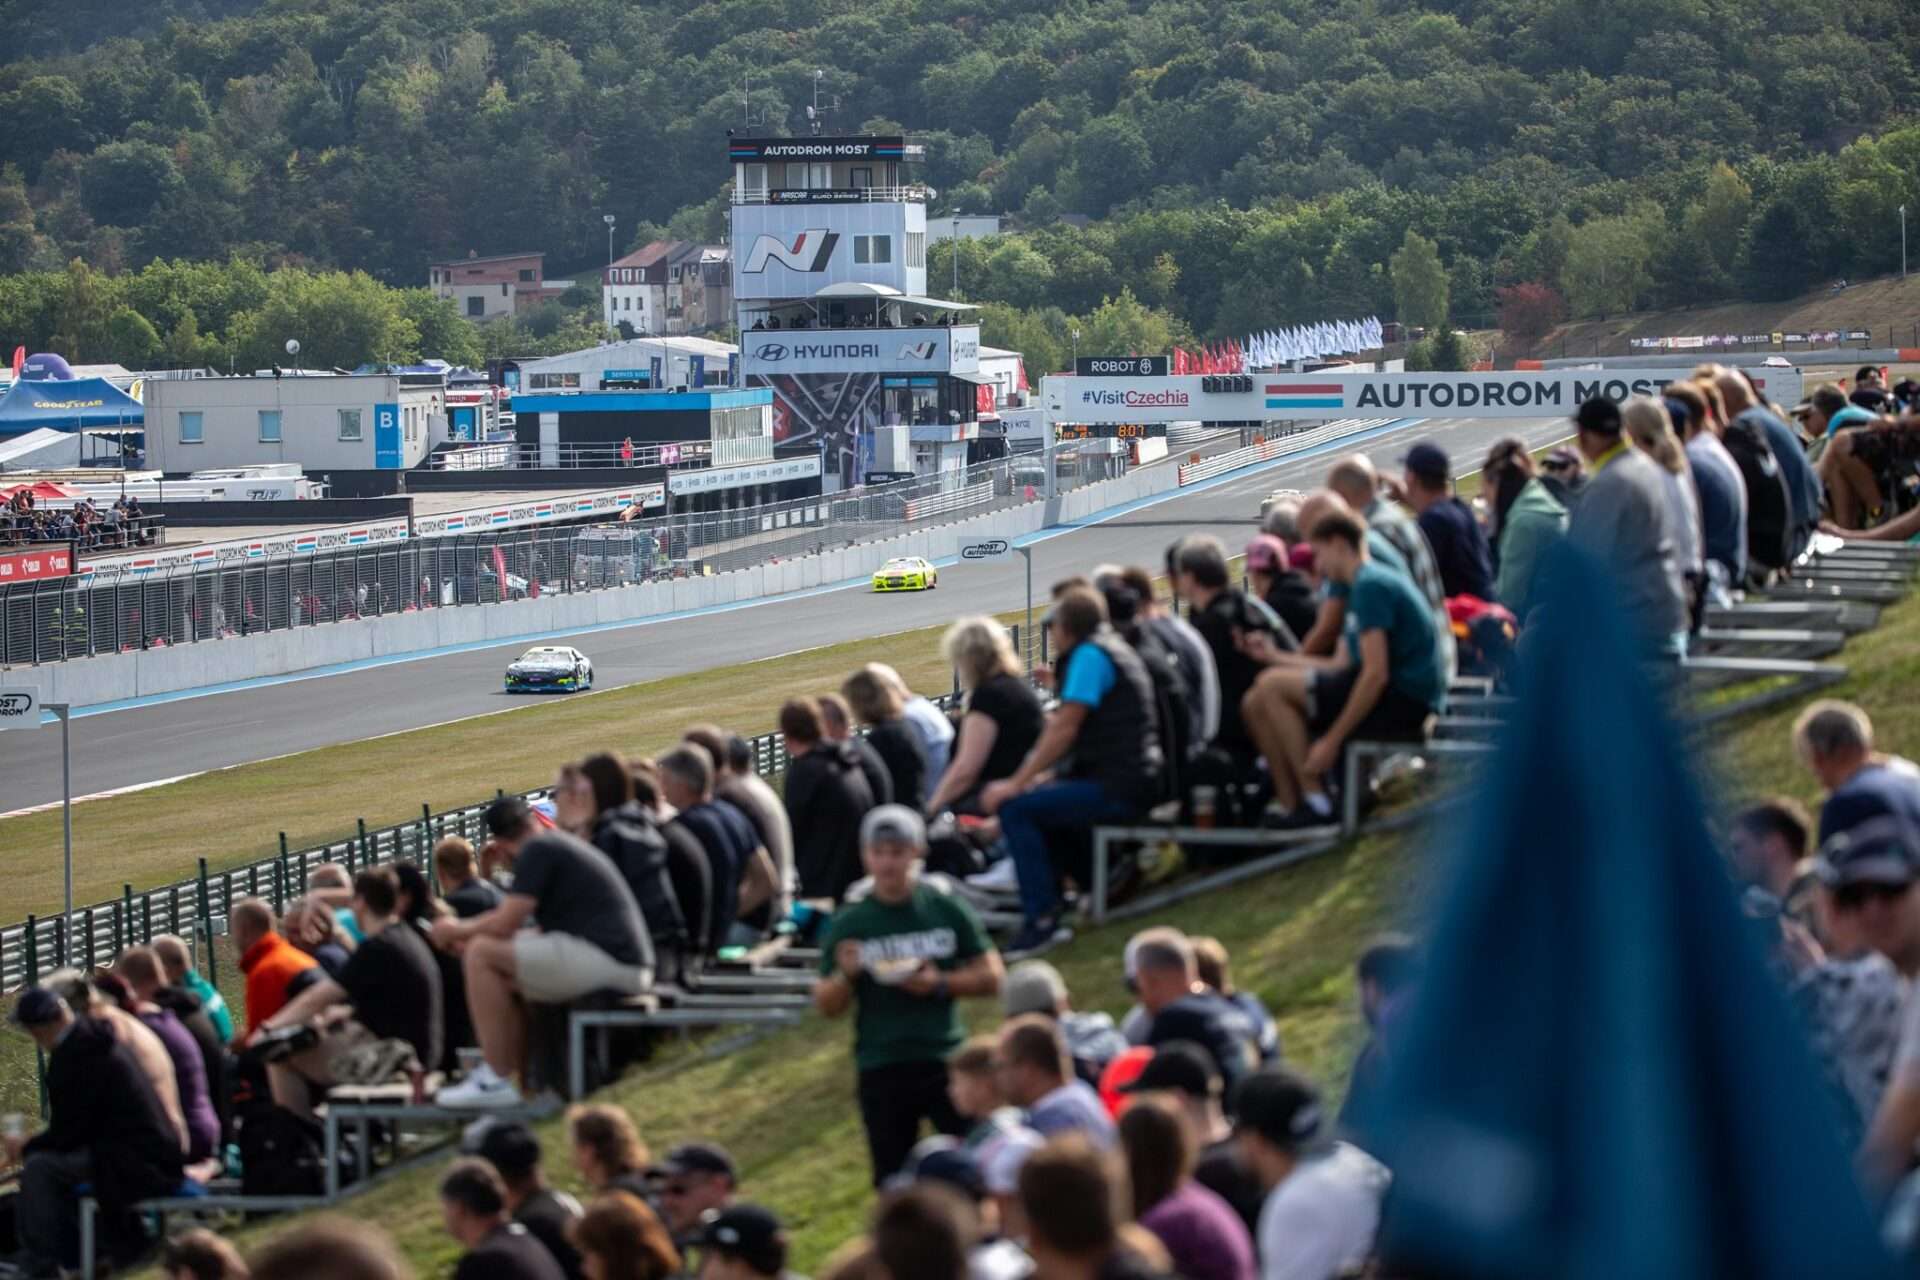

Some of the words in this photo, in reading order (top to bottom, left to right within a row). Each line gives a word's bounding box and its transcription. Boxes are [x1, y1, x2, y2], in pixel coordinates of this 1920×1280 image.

[764, 146, 832, 155] AUTODROM
[835, 145, 869, 154] MOST
[781, 191, 807, 199] NASCAR
[794, 344, 879, 358] HYUNDAI
[1091, 361, 1136, 372] ROBOT
[1082, 389, 1189, 405] #VisitCzechia
[1356, 380, 1562, 409] AUTODROM
[34, 400, 104, 409] GOODYEAR
[380, 412, 393, 428] B
